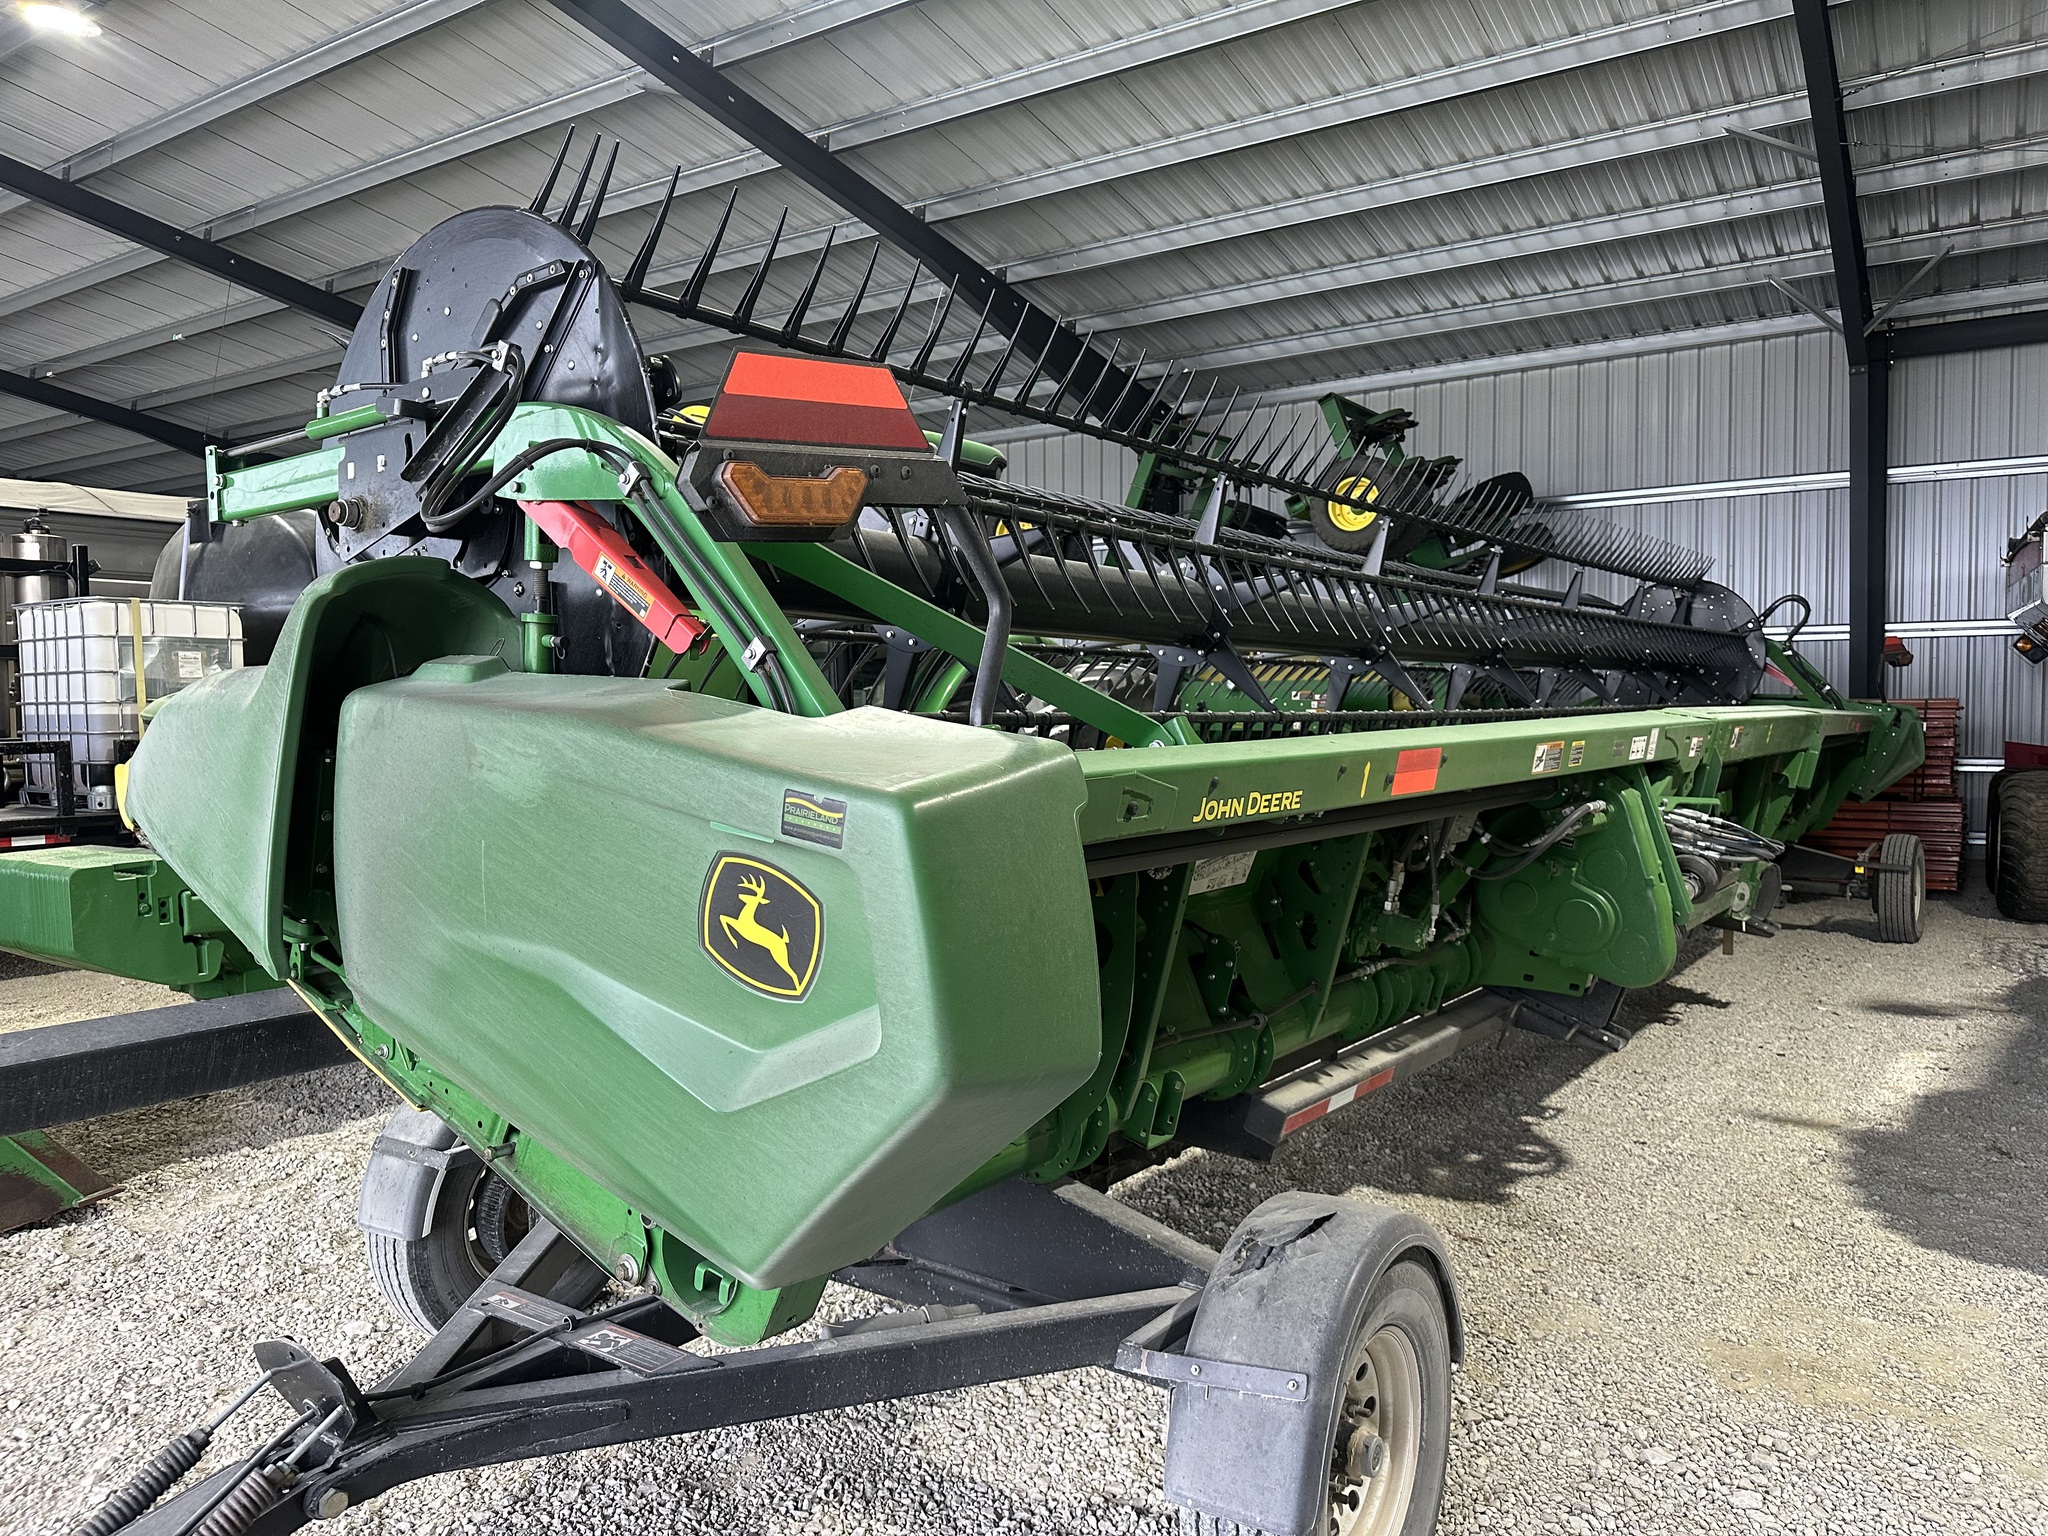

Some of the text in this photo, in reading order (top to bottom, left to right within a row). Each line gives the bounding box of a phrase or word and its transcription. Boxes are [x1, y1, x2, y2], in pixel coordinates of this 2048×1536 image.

[626, 576, 648, 599] WARNING
[1192, 790, 1304, 823] JOHN DEERE
